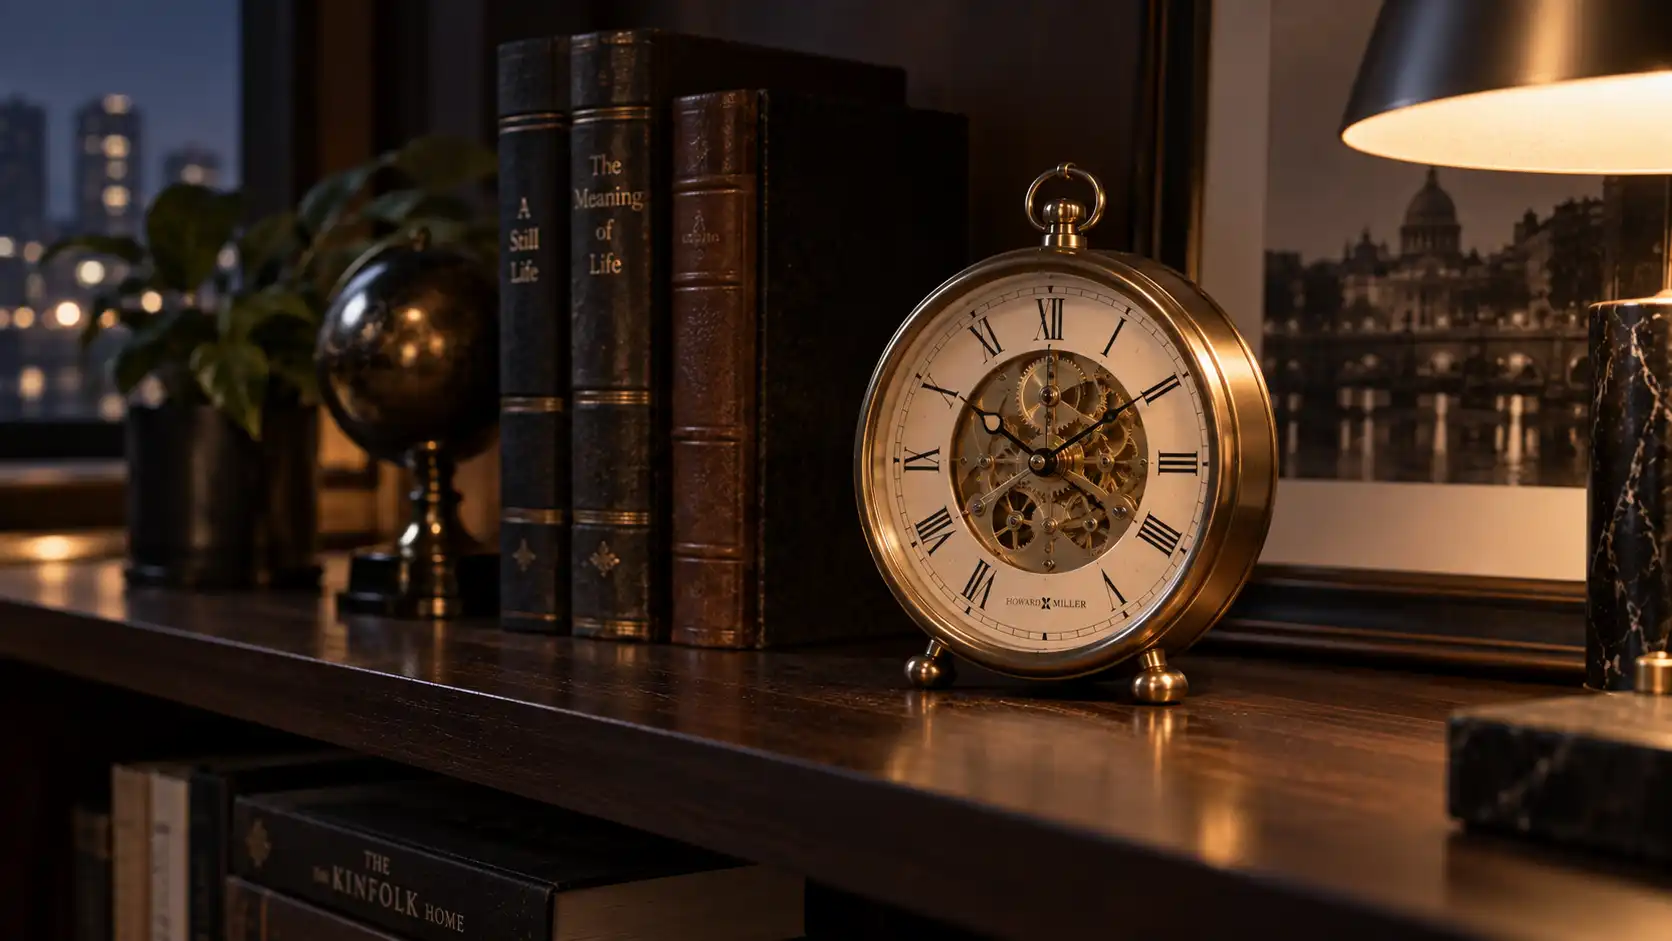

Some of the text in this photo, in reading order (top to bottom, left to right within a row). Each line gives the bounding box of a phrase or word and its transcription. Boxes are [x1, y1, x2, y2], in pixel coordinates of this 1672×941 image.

[588, 153, 623, 177] The
[516, 196, 532, 220] A
[574, 185, 645, 212] Meaning
[509, 226, 541, 252] Still
[595, 218, 615, 241] of
[510, 258, 540, 284] Life
[589, 251, 623, 276] Life
[1033, 297, 1064, 341] XII
[1158, 450, 1198, 476] III
[1135, 510, 1182, 559] IIII
[1006, 597, 1087, 608] HOWARD MILLER
[364, 850, 391, 875] THE
[332, 865, 419, 918] KINFOLK
[425, 903, 465, 933] HOME
